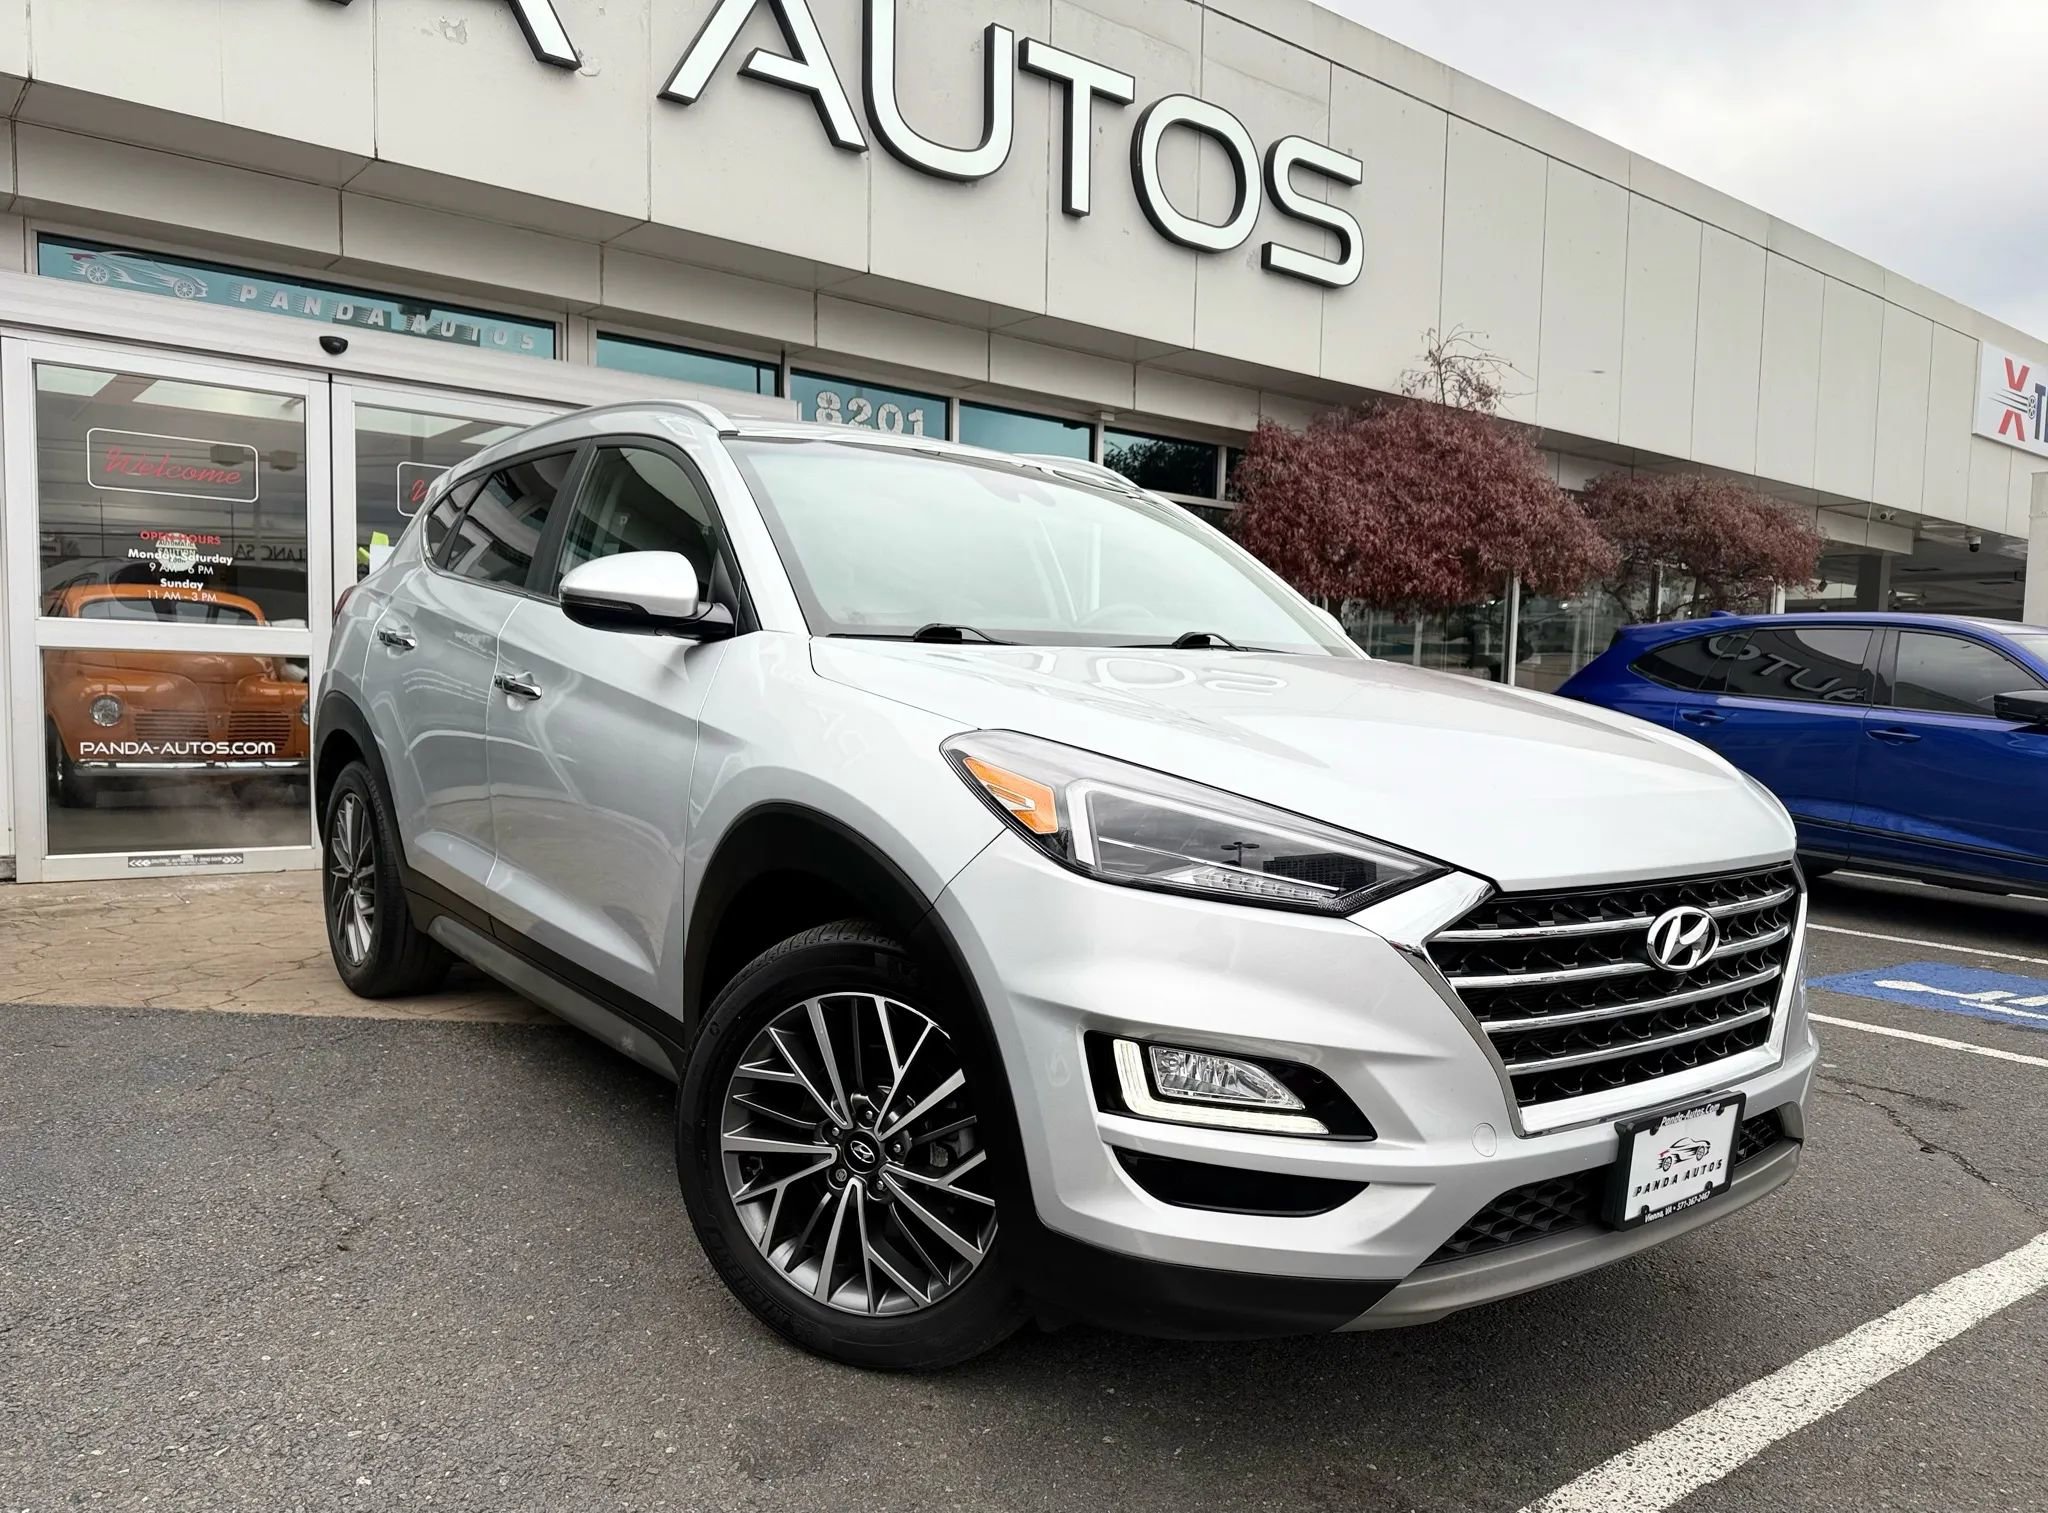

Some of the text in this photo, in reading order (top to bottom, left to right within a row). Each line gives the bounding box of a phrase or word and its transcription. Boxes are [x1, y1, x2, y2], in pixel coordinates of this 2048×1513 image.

[657, 0, 1365, 289] AUTOS
[236, 283, 535, 350] PANDA AUTOS
[814, 391, 924, 437] 8201
[103, 447, 242, 486] Welcome
[139, 531, 222, 546] OPEN HOURS
[149, 562, 156, 573] 9
[198, 565, 214, 575] PM
[160, 578, 204, 592] Sunday
[147, 589, 159, 600] 11
[163, 590, 181, 601] AM
[191, 592, 198, 602] 3
[201, 592, 218, 603] PM
[1633, 1158, 1723, 1197] PANDA AUTOS
